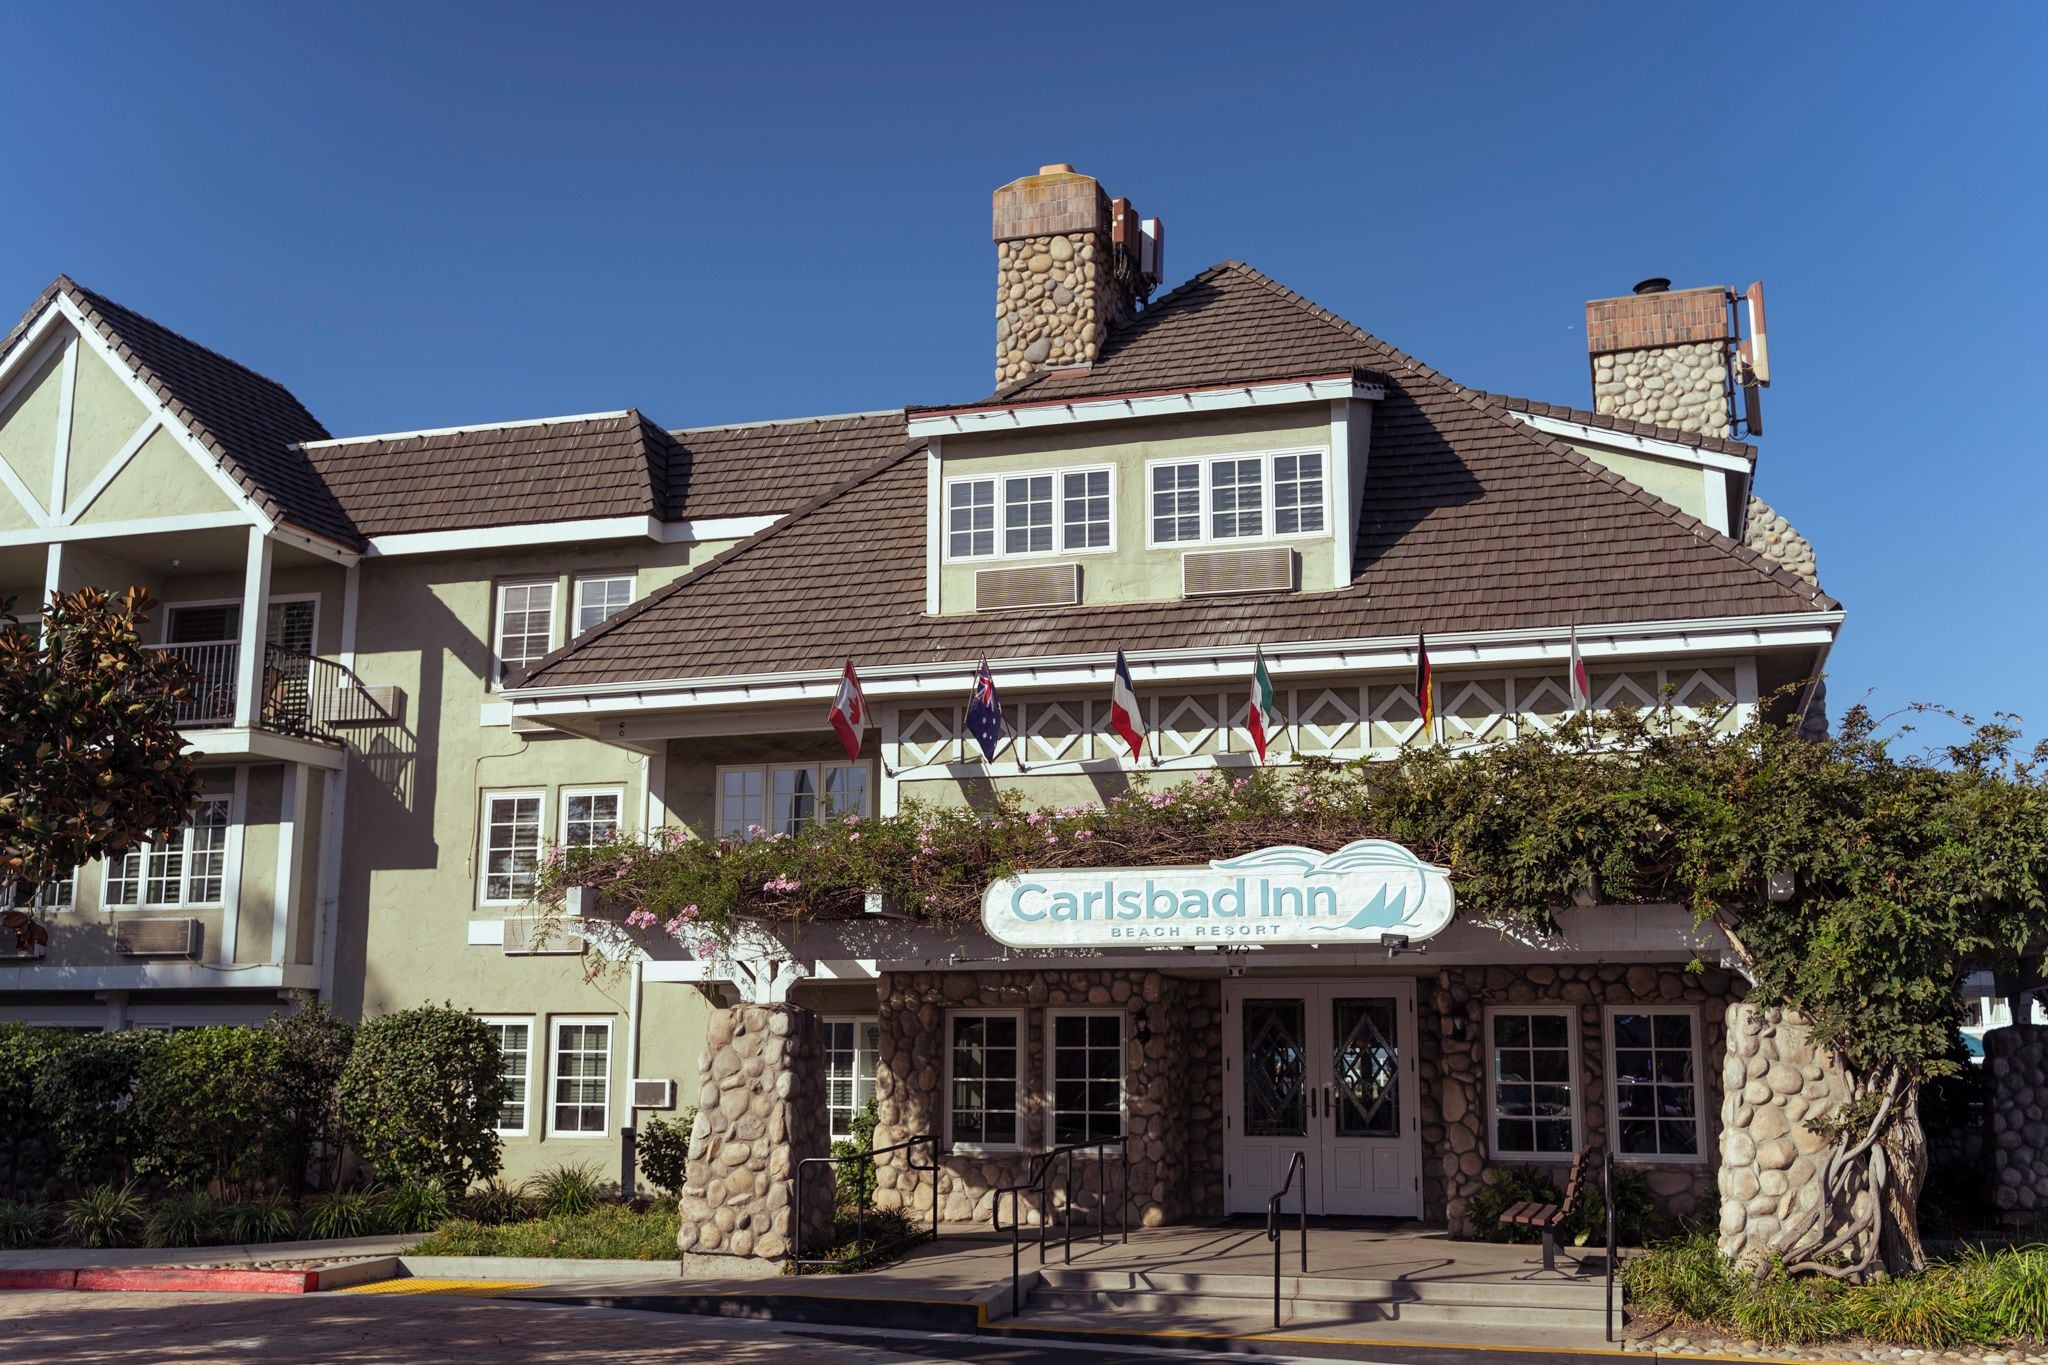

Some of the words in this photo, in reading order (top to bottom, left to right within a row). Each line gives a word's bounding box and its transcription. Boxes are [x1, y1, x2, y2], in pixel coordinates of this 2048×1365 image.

[1012, 878, 1246, 921] Carlsbad
[1262, 879, 1338, 917] Inn
[1111, 927, 1180, 938] BEACH
[1196, 925, 1281, 937] RESORT
